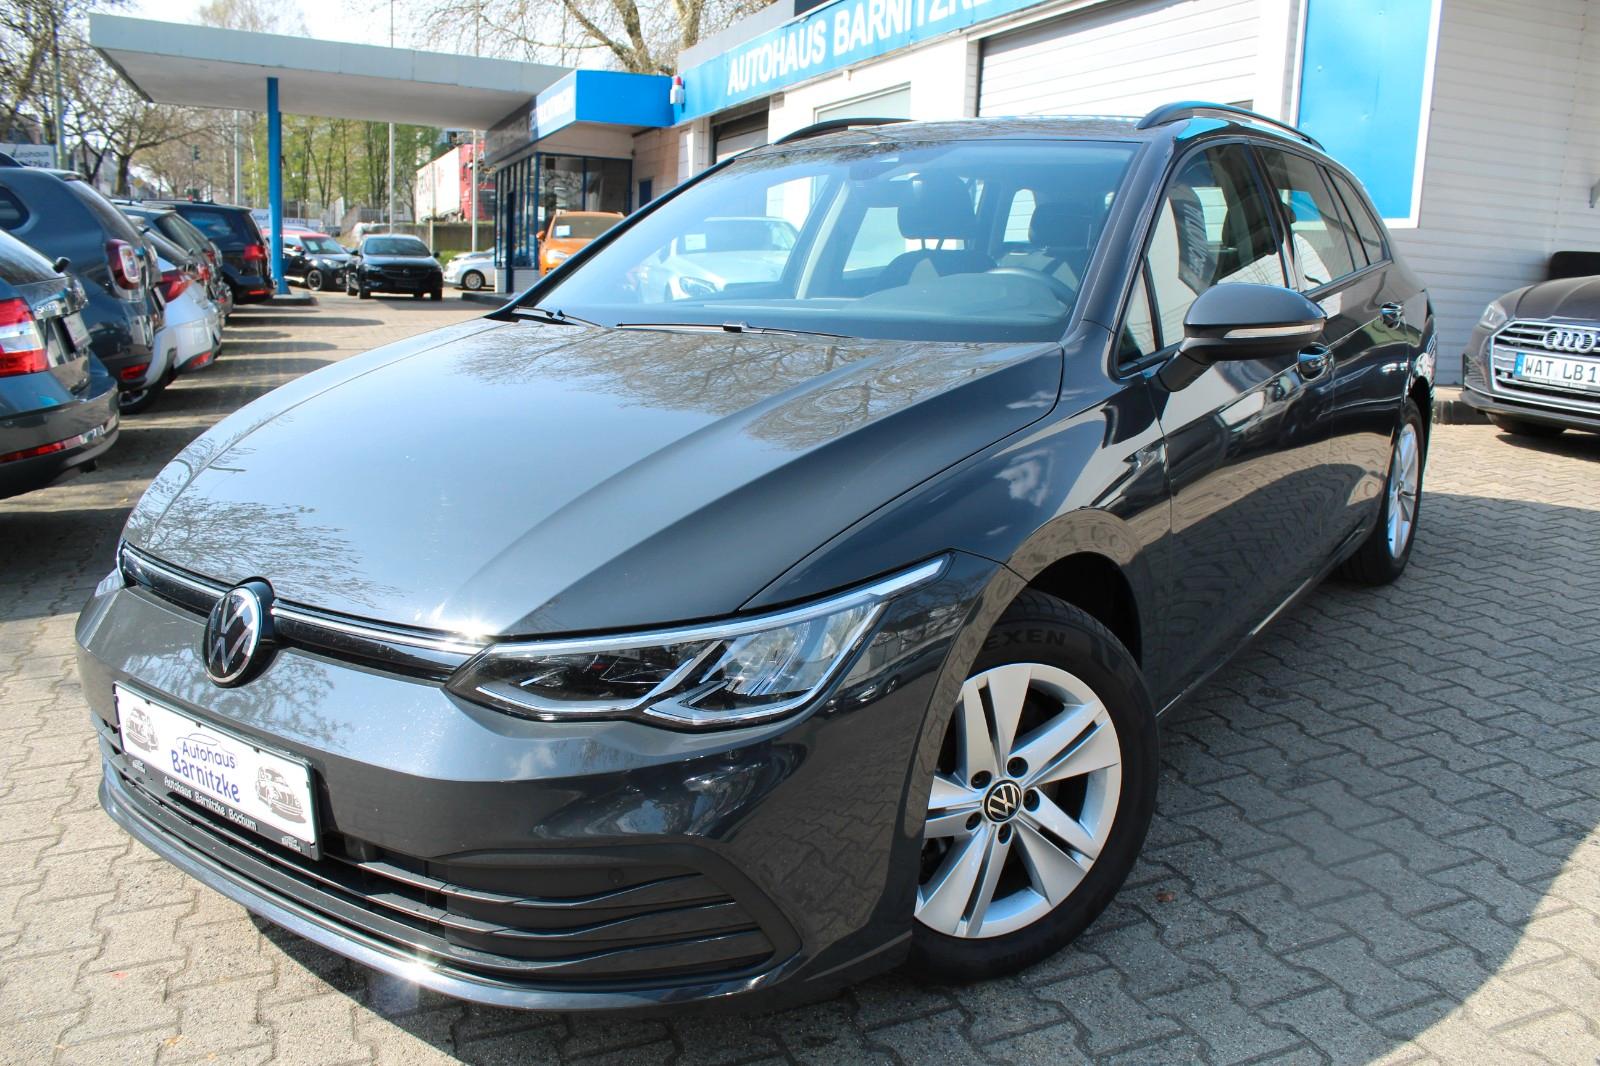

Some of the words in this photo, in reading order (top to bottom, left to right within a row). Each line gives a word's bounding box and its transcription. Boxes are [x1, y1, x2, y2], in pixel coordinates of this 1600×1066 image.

[727, 20, 827, 96] AUTOHAUS
[1525, 357, 1554, 377] WAT
[984, 628, 1067, 652] EXEN
[182, 740, 236, 769] Autohaus
[170, 749, 241, 803] Barnitzke
[194, 791, 226, 817] Barnitzke
[228, 808, 258, 832] Bochum
